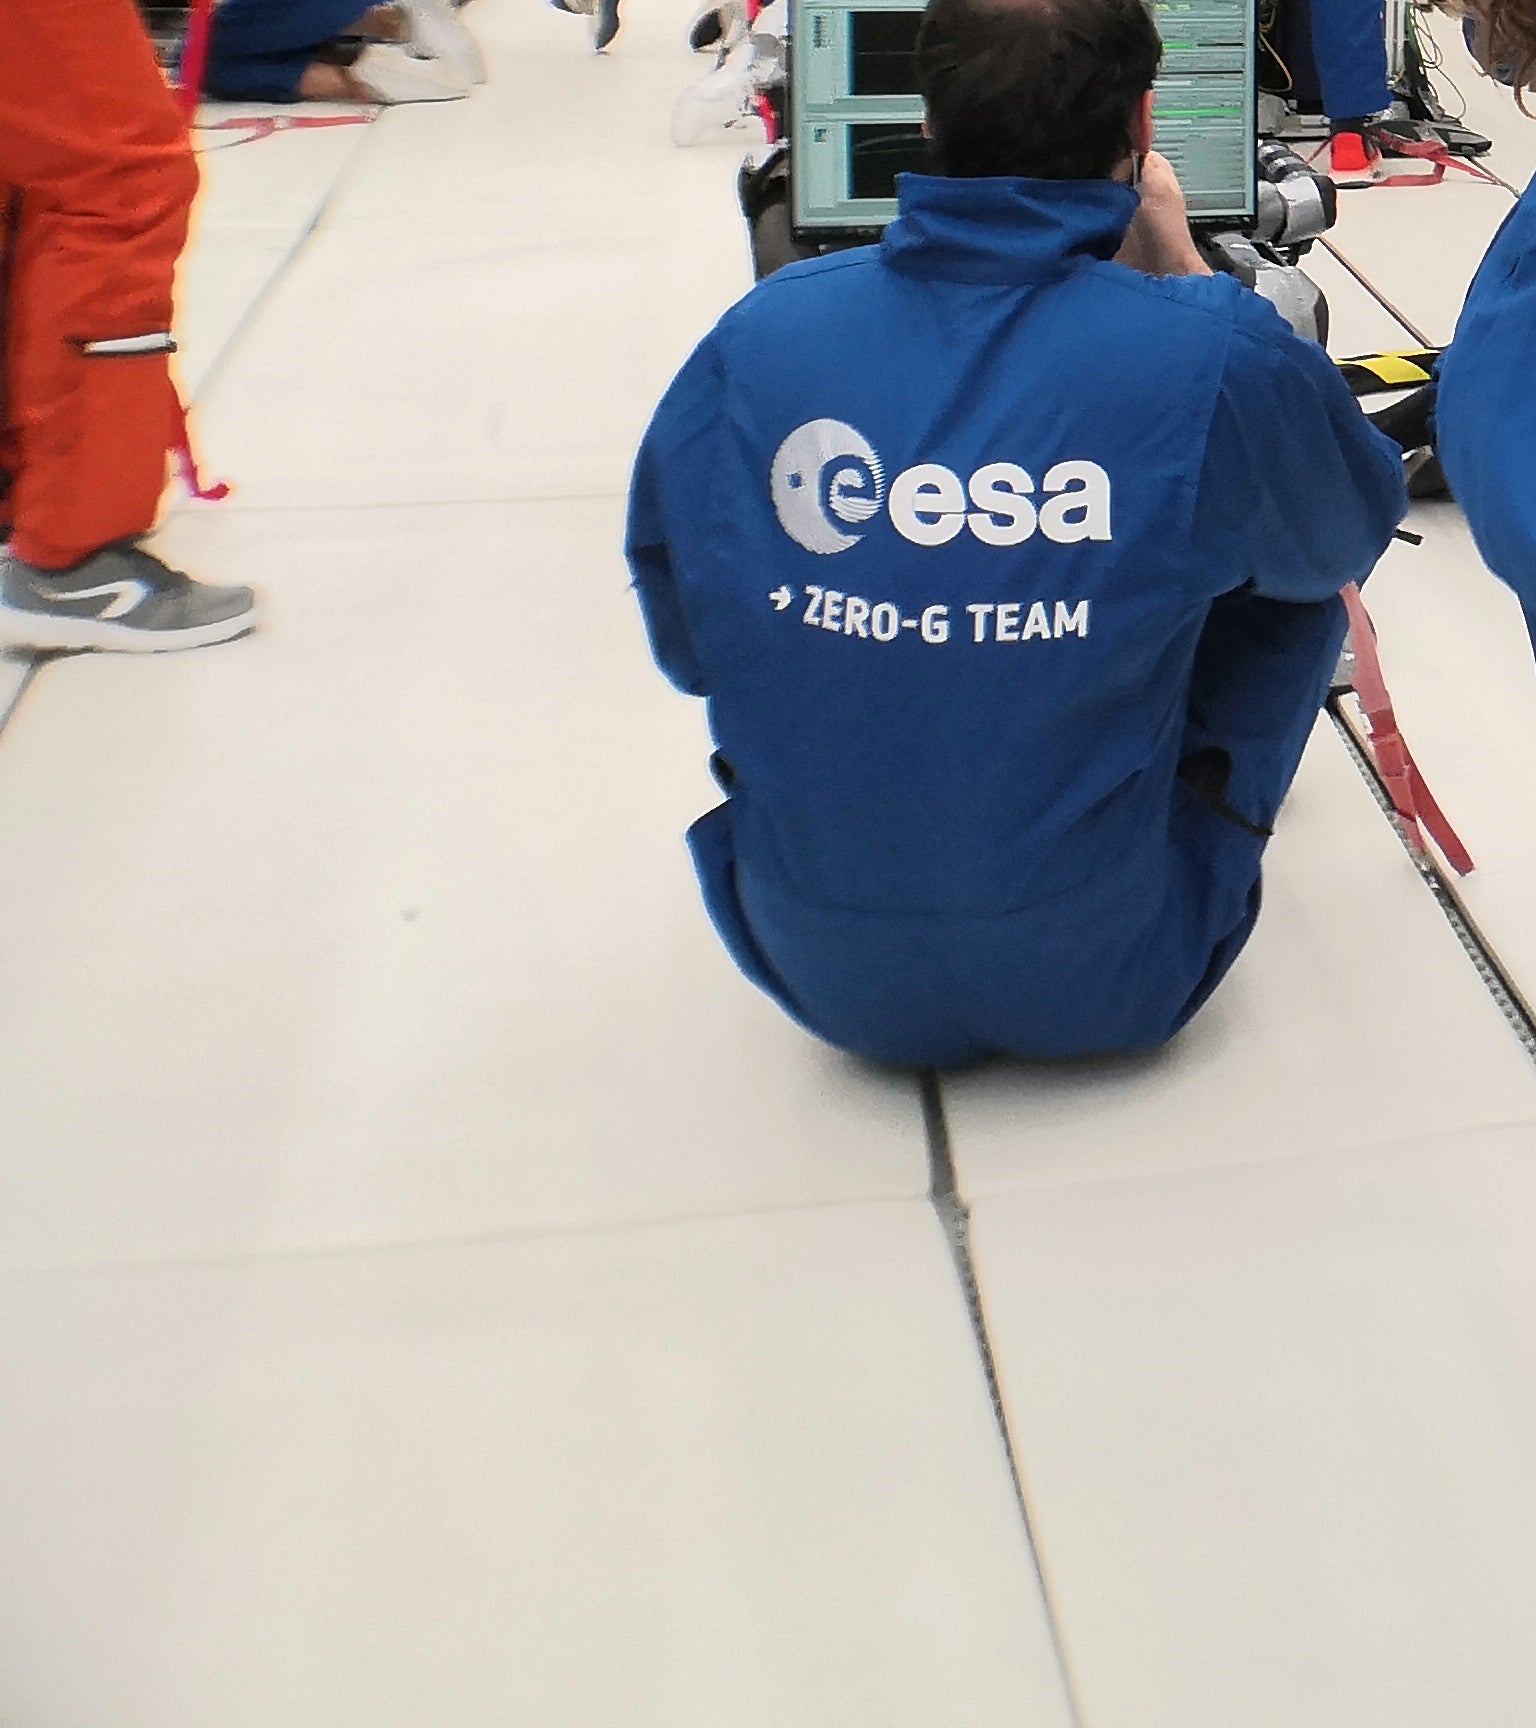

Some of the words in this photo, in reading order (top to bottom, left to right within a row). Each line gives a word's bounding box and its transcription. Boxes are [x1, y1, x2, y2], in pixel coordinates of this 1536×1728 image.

[888, 459, 1112, 546] esa
[802, 584, 951, 643] ZERO-G
[966, 598, 1091, 644] TEAM
